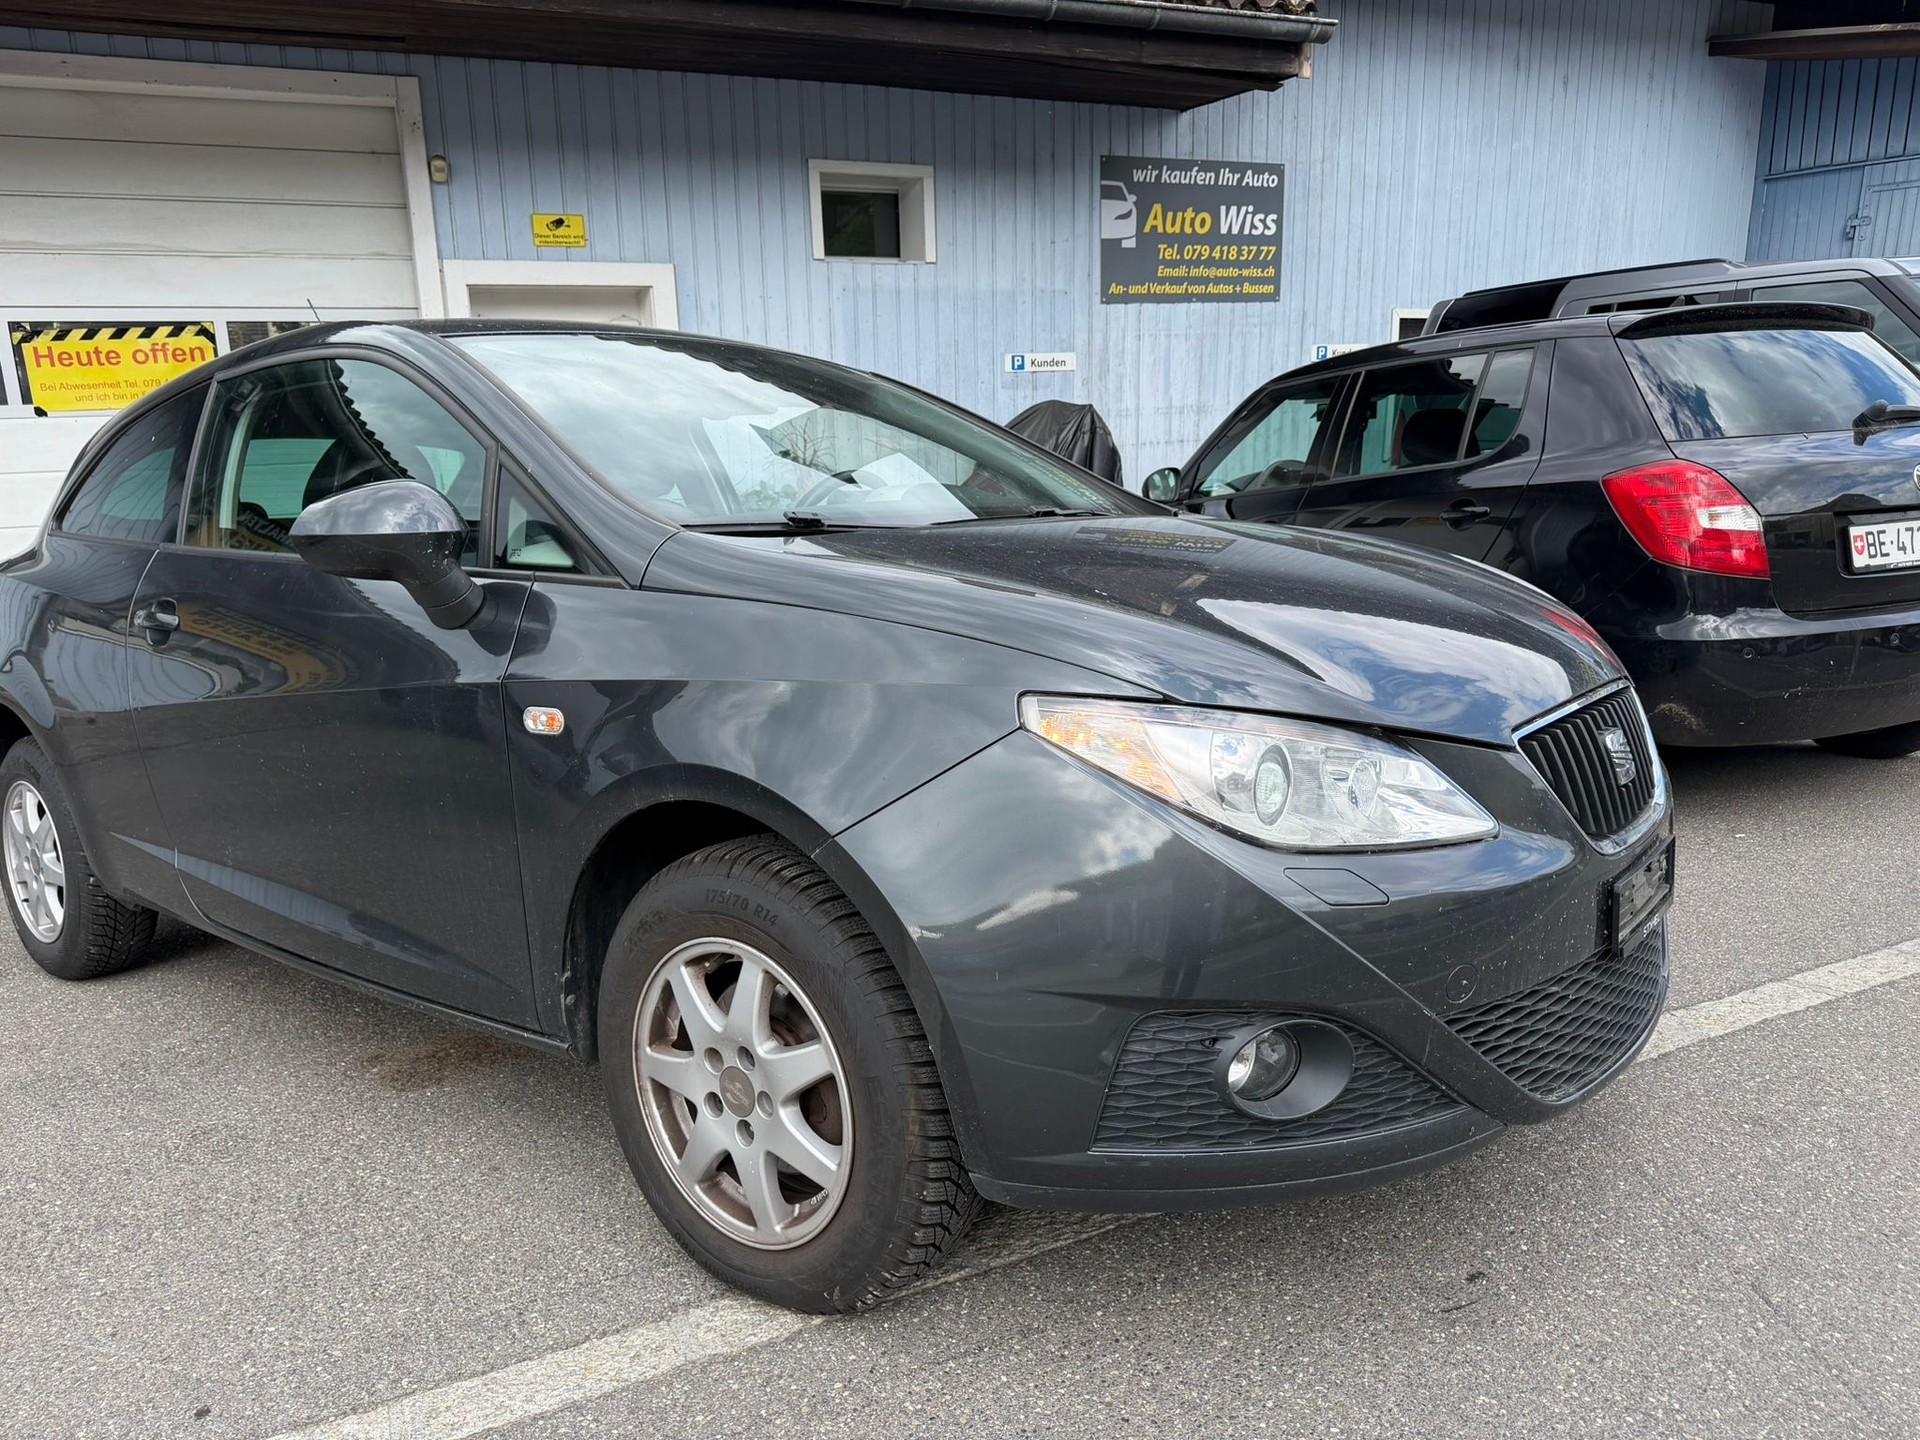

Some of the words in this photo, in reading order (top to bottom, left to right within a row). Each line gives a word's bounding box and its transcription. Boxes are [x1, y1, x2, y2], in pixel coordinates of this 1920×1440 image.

[1132, 165, 1159, 183] wir
[1161, 165, 1215, 185] kaufen
[1218, 168, 1241, 186] Ihr
[1242, 169, 1279, 188] Auto
[1143, 203, 1213, 235] Auto
[1219, 205, 1278, 236] Wiss
[1157, 243, 1181, 260] Tel.
[1183, 245, 1210, 260] 079
[1211, 245, 1238, 260] 418
[1239, 246, 1258, 261] 37
[1259, 246, 1277, 261] 77
[1157, 265, 1189, 277] Email:
[1189, 265, 1275, 278] info@auto-wiss.ch
[1109, 282, 1127, 295] An-
[1128, 283, 1148, 295] und
[1150, 282, 1188, 294] Verkauf
[1188, 285, 1205, 294] von
[1206, 282, 1234, 294] Autos
[1242, 282, 1275, 294] Bussen
[32, 345, 121, 368] Heute
[132, 342, 207, 365] offen
[1030, 357, 1067, 368] Kunden
[40, 382, 57, 391] Bei
[59, 380, 122, 391] Abwesenheit
[123, 379, 140, 388] Tel.
[143, 378, 161, 388] 079
[75, 394, 94, 402] und
[96, 392, 110, 401] ich
[113, 391, 128, 400] bin
[130, 391, 139, 400] in
[705, 888, 750, 912] 175/70
[753, 903, 779, 927] R14
